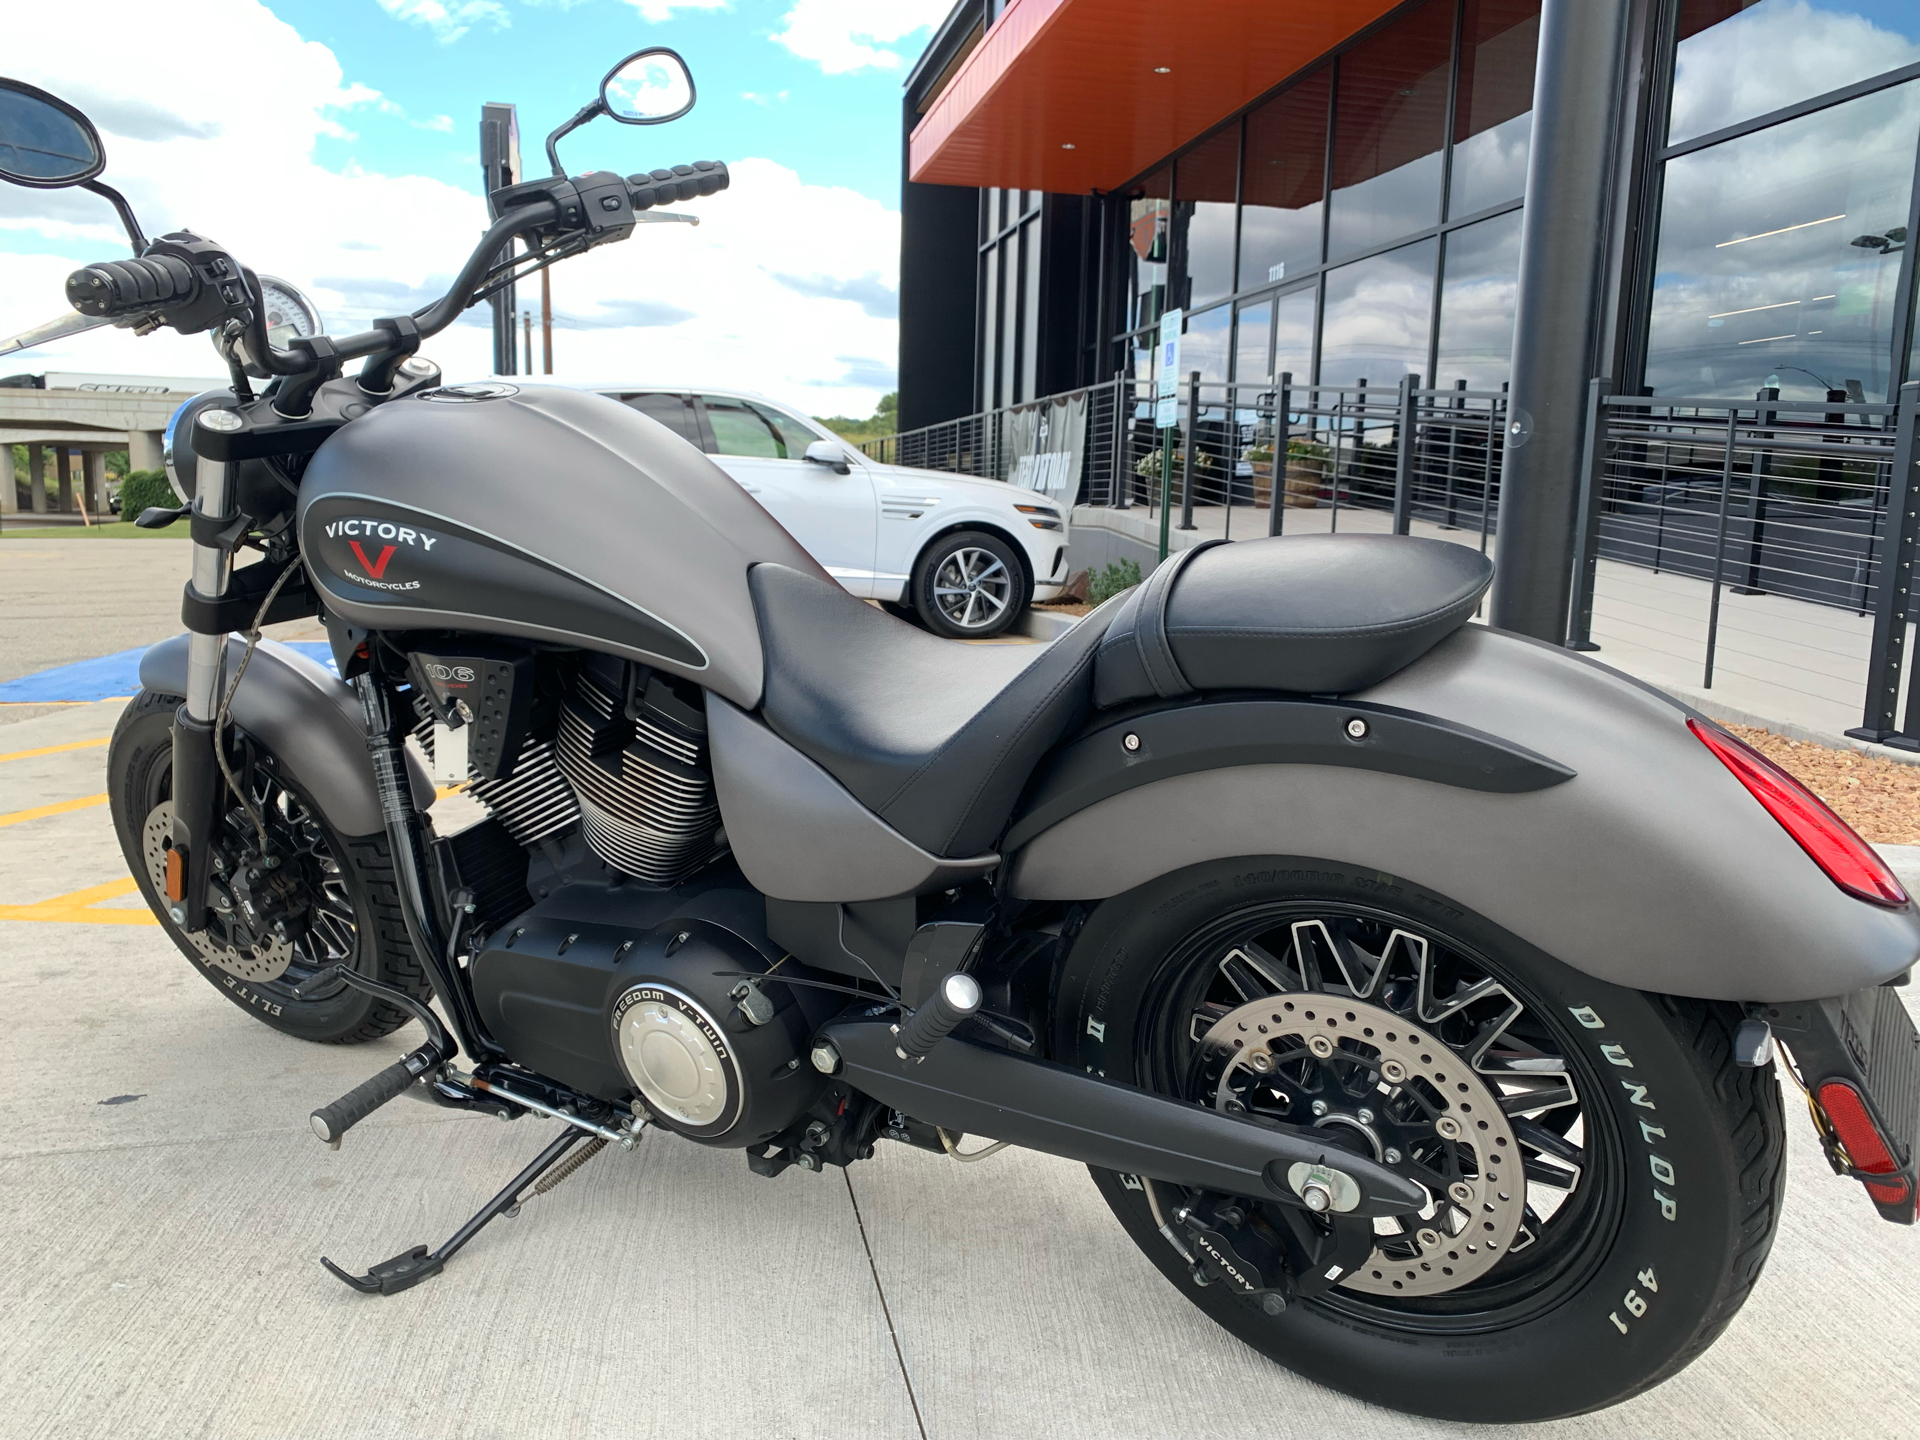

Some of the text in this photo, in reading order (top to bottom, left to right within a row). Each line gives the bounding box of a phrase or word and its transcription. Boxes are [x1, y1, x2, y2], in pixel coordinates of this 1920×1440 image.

[325, 520, 437, 551] VICTORY
[343, 569, 420, 590] MOTORCYCLES
[347, 540, 398, 579] V
[426, 663, 475, 682] 106
[223, 975, 283, 1016] ELITE
[613, 990, 728, 1060] FREEDOM V-TWIN
[1567, 1004, 1678, 1336] DUNLOP 491
[1199, 1236, 1255, 1291] VICTORY
